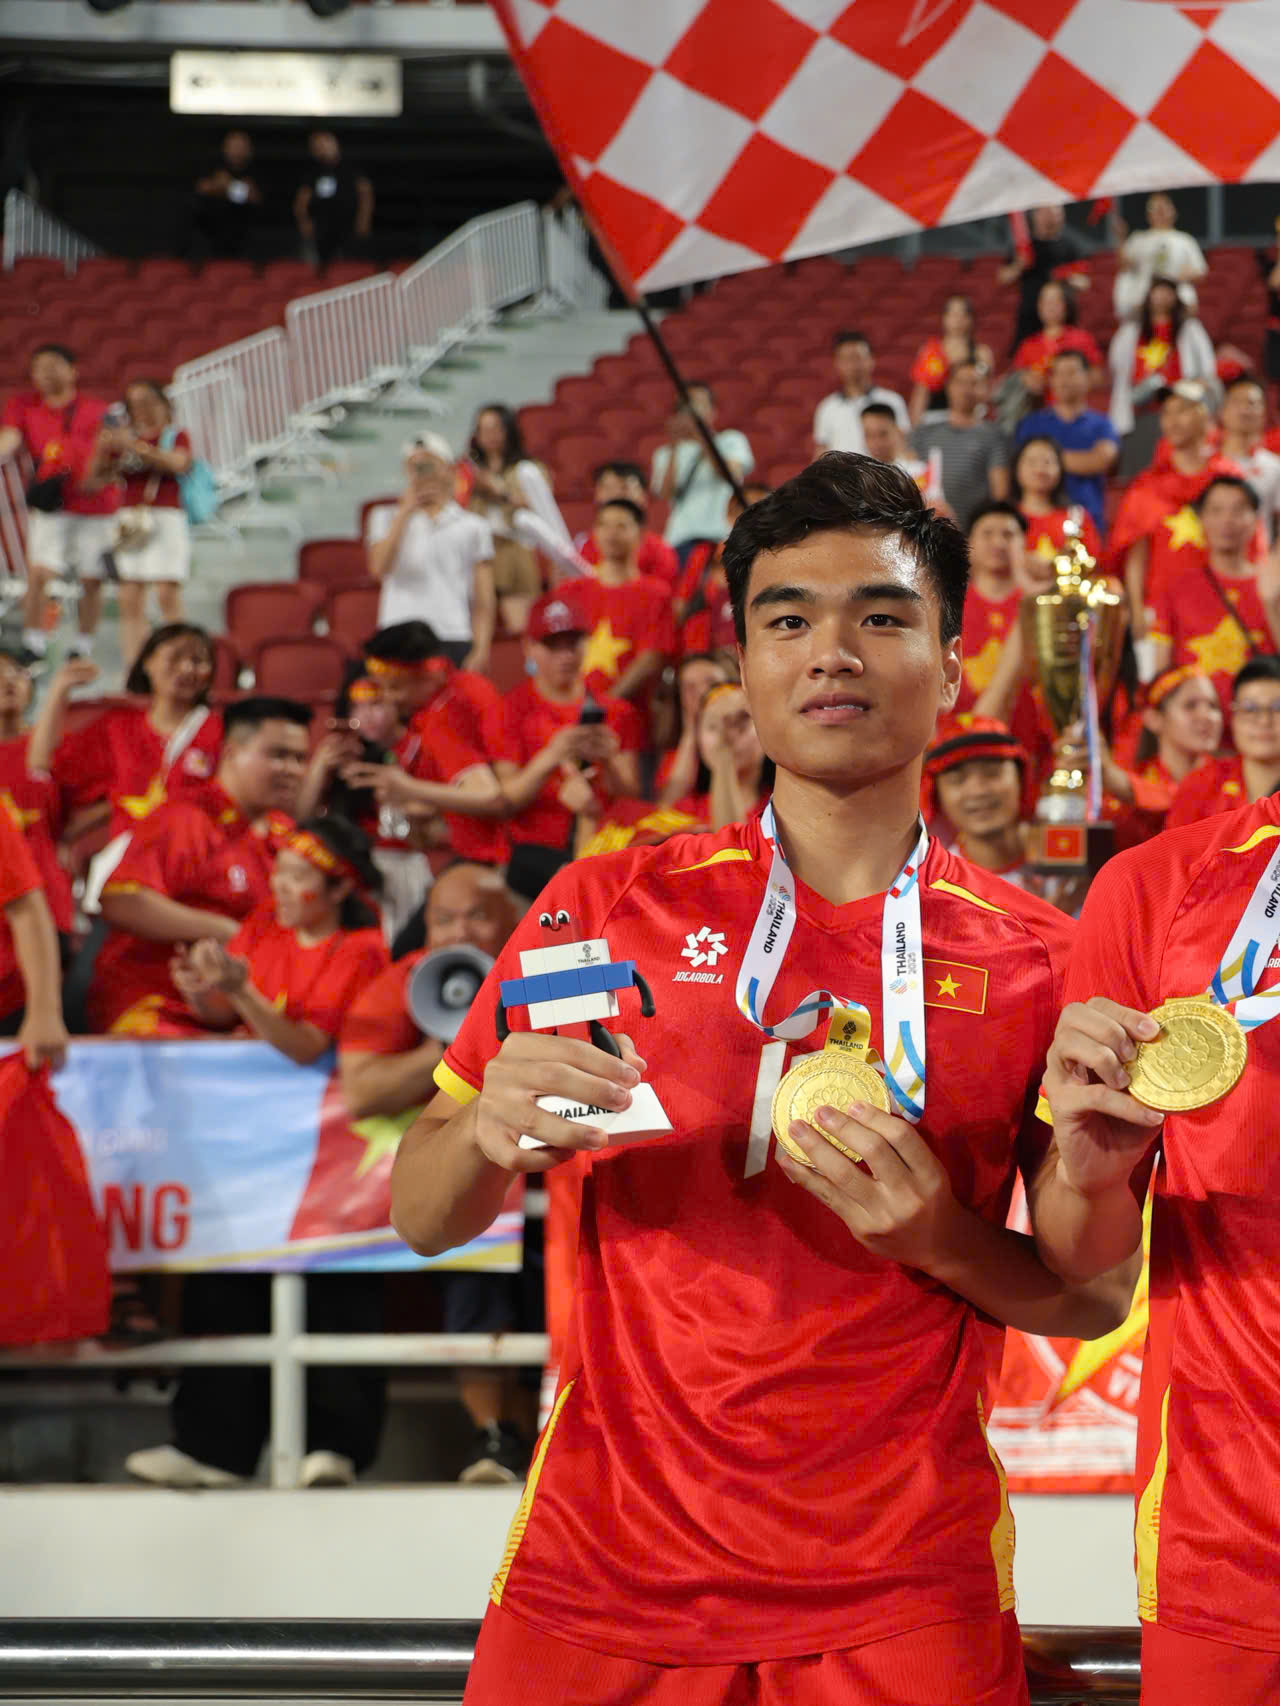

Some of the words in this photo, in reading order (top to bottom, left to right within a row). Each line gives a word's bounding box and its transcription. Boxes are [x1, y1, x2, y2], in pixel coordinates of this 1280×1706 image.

[763, 900, 786, 954] THAILAND
[896, 922, 907, 976] THAILAND
[829, 1038, 864, 1050] THAILAND
